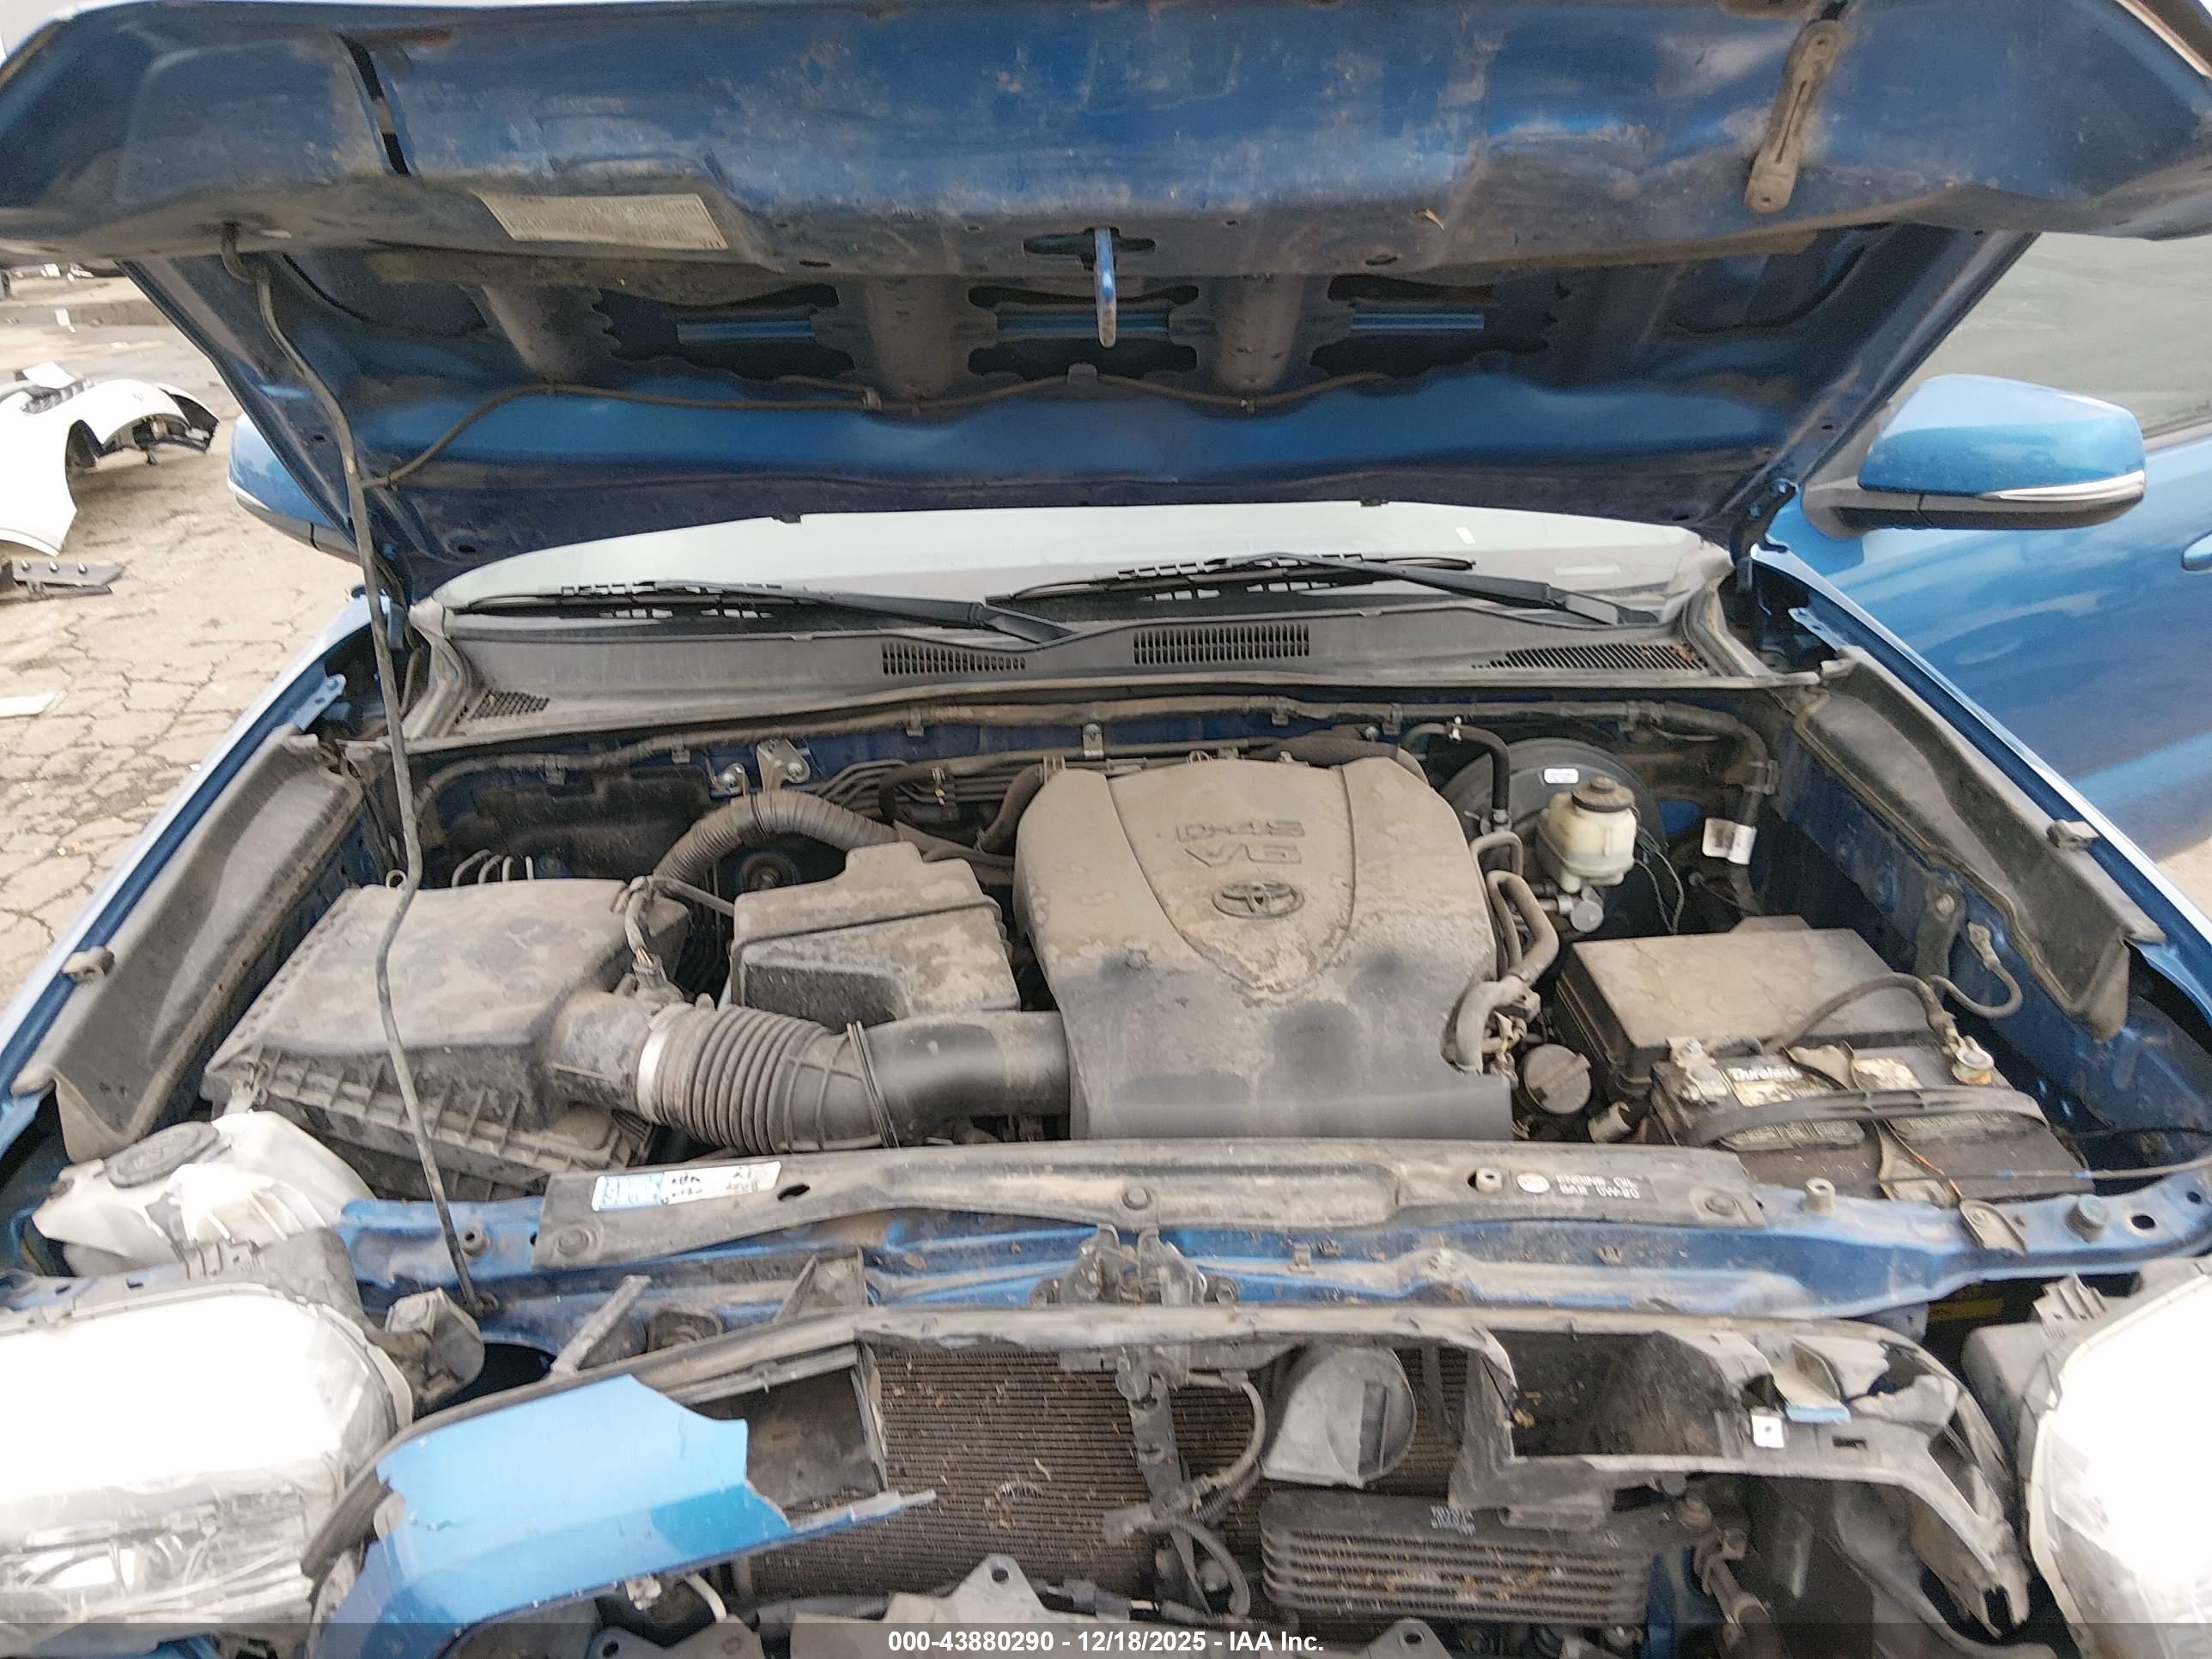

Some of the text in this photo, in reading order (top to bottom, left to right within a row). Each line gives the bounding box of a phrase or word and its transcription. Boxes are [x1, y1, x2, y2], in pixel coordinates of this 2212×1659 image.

[1184, 842, 1303, 868] V6
[1556, 1174, 1639, 1190] ENGINE OIL
